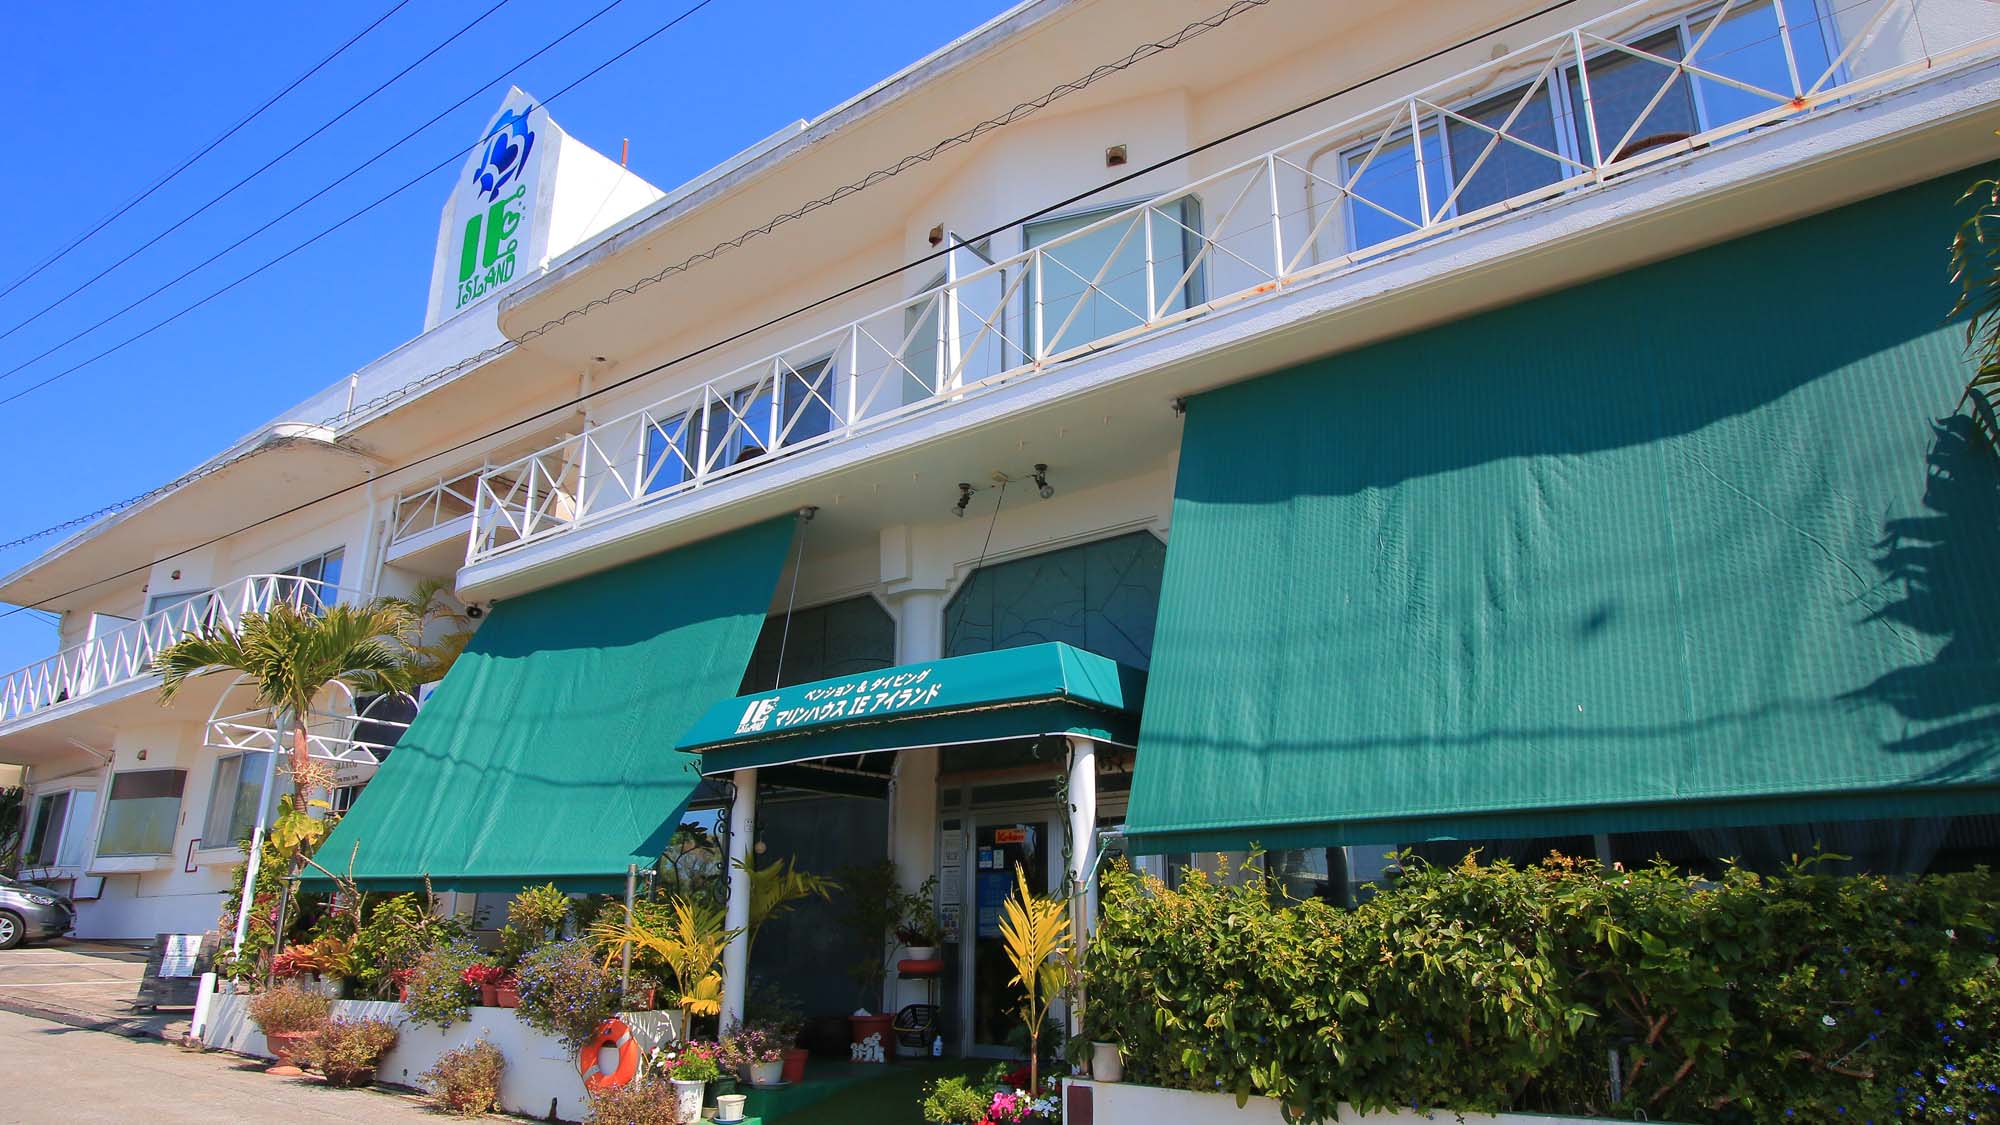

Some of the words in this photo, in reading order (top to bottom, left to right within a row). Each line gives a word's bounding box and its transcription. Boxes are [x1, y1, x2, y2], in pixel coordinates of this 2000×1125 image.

[455, 254, 515, 309] ISLAND
[776, 700, 847, 727] マリンハウス
[847, 695, 871, 716] IE
[869, 683, 942, 713] アイランド
[804, 682, 855, 701] ペンション
[856, 680, 868, 693] &
[869, 668, 932, 692] ダイビング
